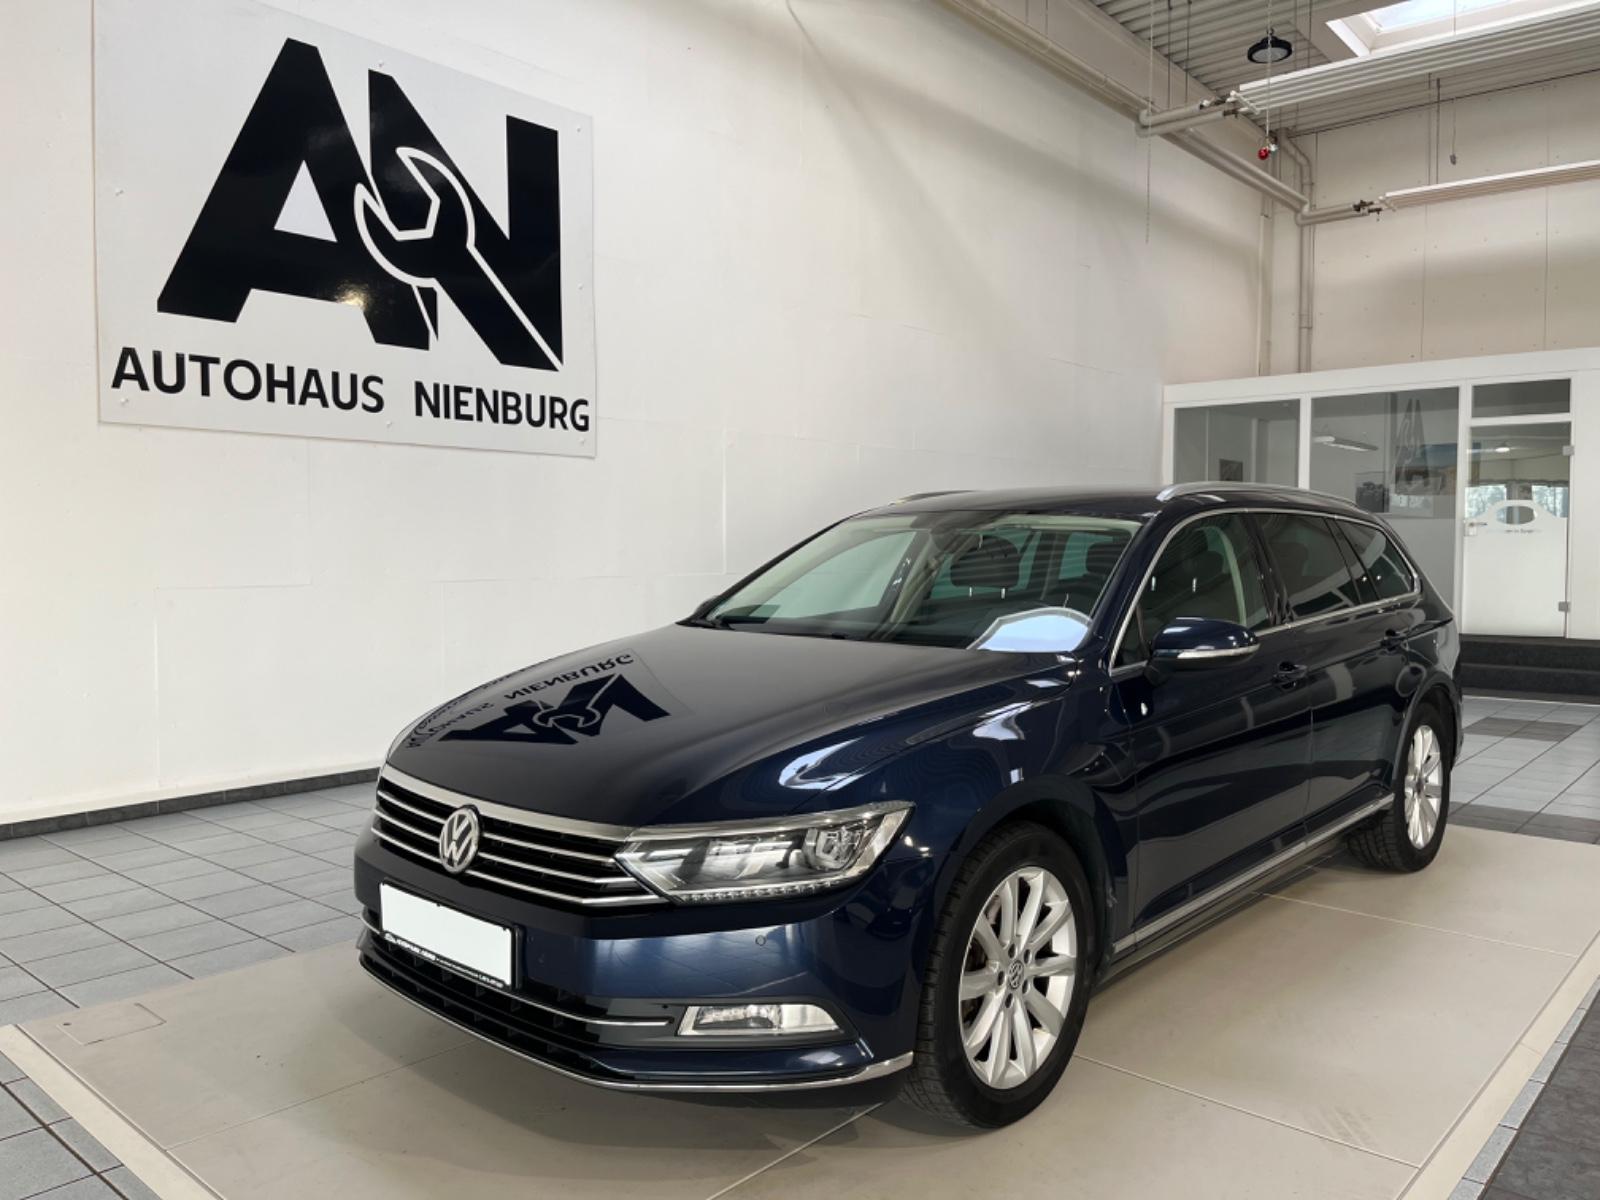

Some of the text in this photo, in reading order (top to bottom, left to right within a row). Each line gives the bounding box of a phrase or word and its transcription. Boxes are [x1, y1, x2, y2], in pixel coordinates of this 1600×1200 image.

[156, 37, 564, 372] AN
[111, 346, 591, 432] AUTOHAUS NIENBURG
[440, 807, 480, 874] VW
